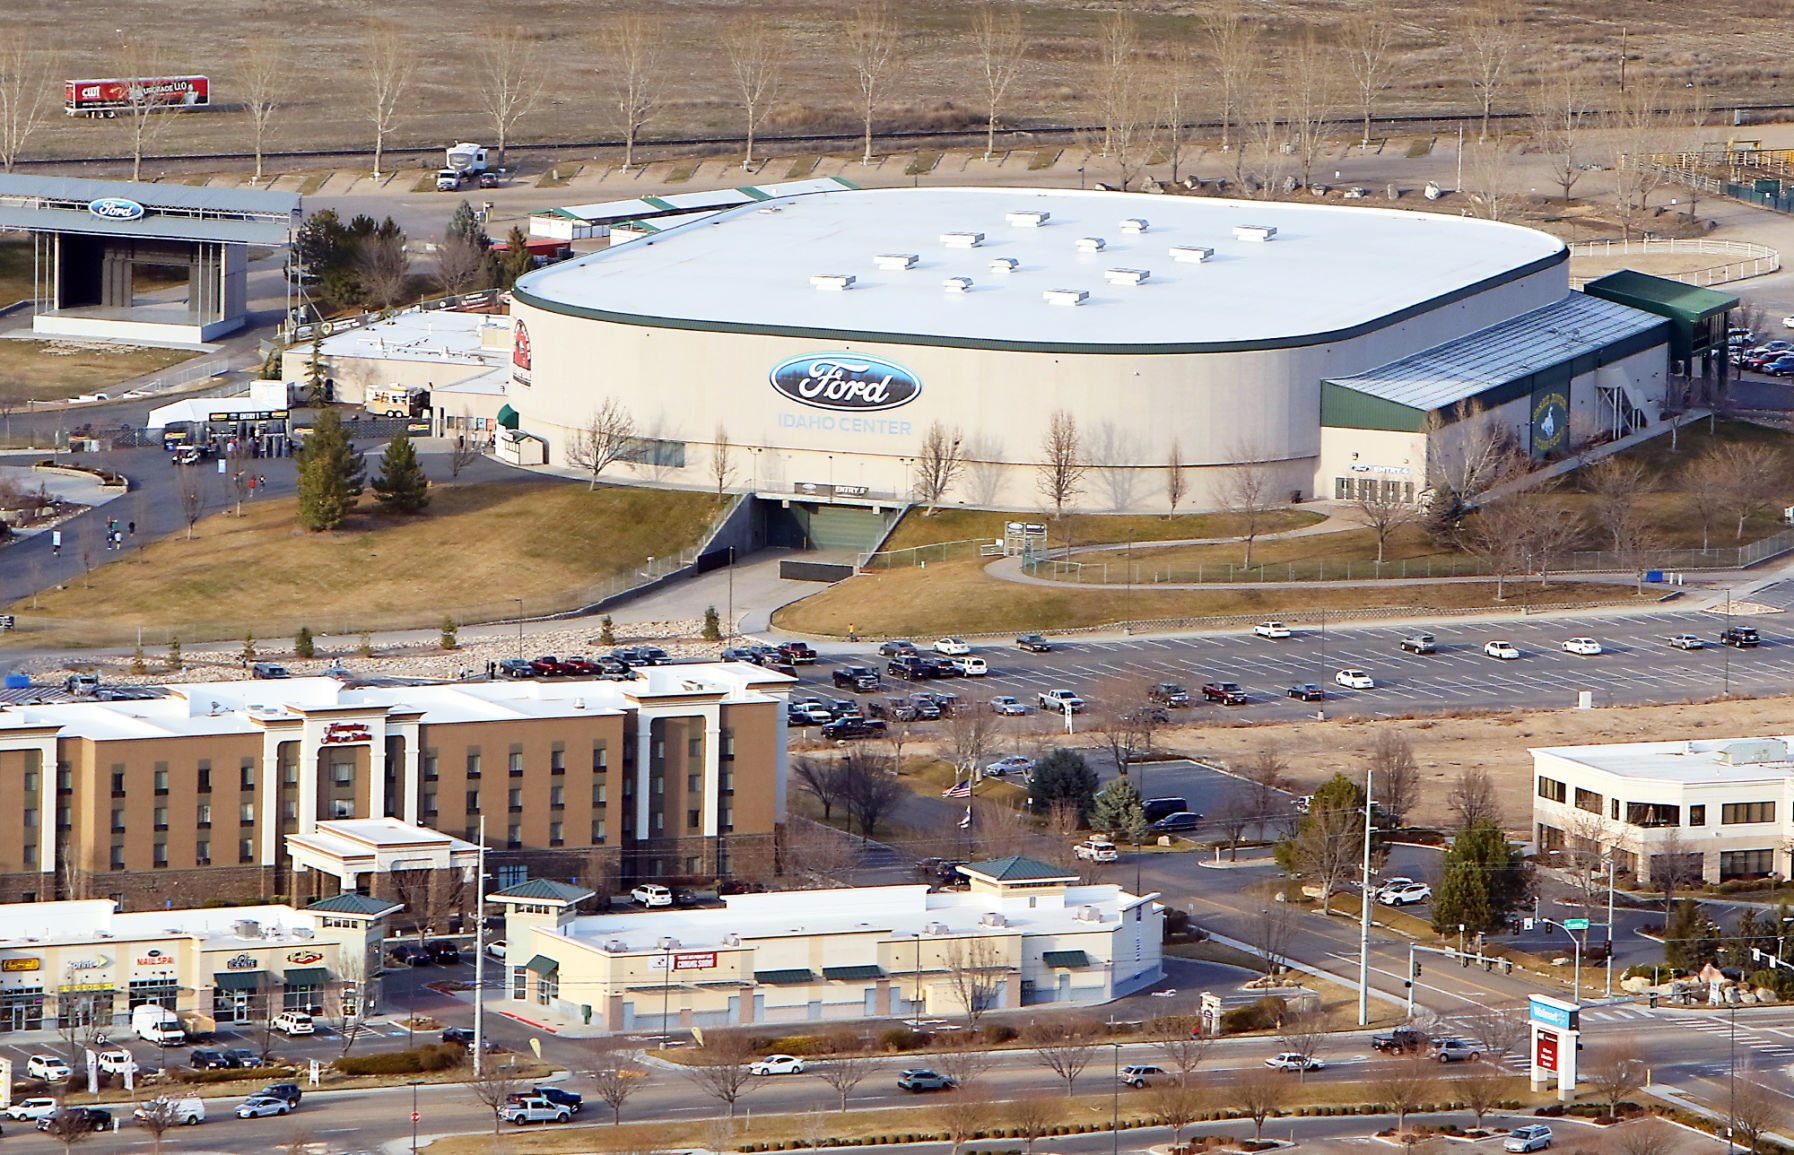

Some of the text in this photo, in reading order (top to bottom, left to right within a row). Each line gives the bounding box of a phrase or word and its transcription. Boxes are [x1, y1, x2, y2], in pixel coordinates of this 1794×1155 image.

[99, 200, 134, 216] Ford
[799, 360, 893, 403] Ford
[778, 414, 912, 435] IDAHO CENTER
[835, 485, 859, 494] ENTRY
[137, 956, 174, 966] NAIL SPA
[1533, 1005, 1558, 1022] Walmart
